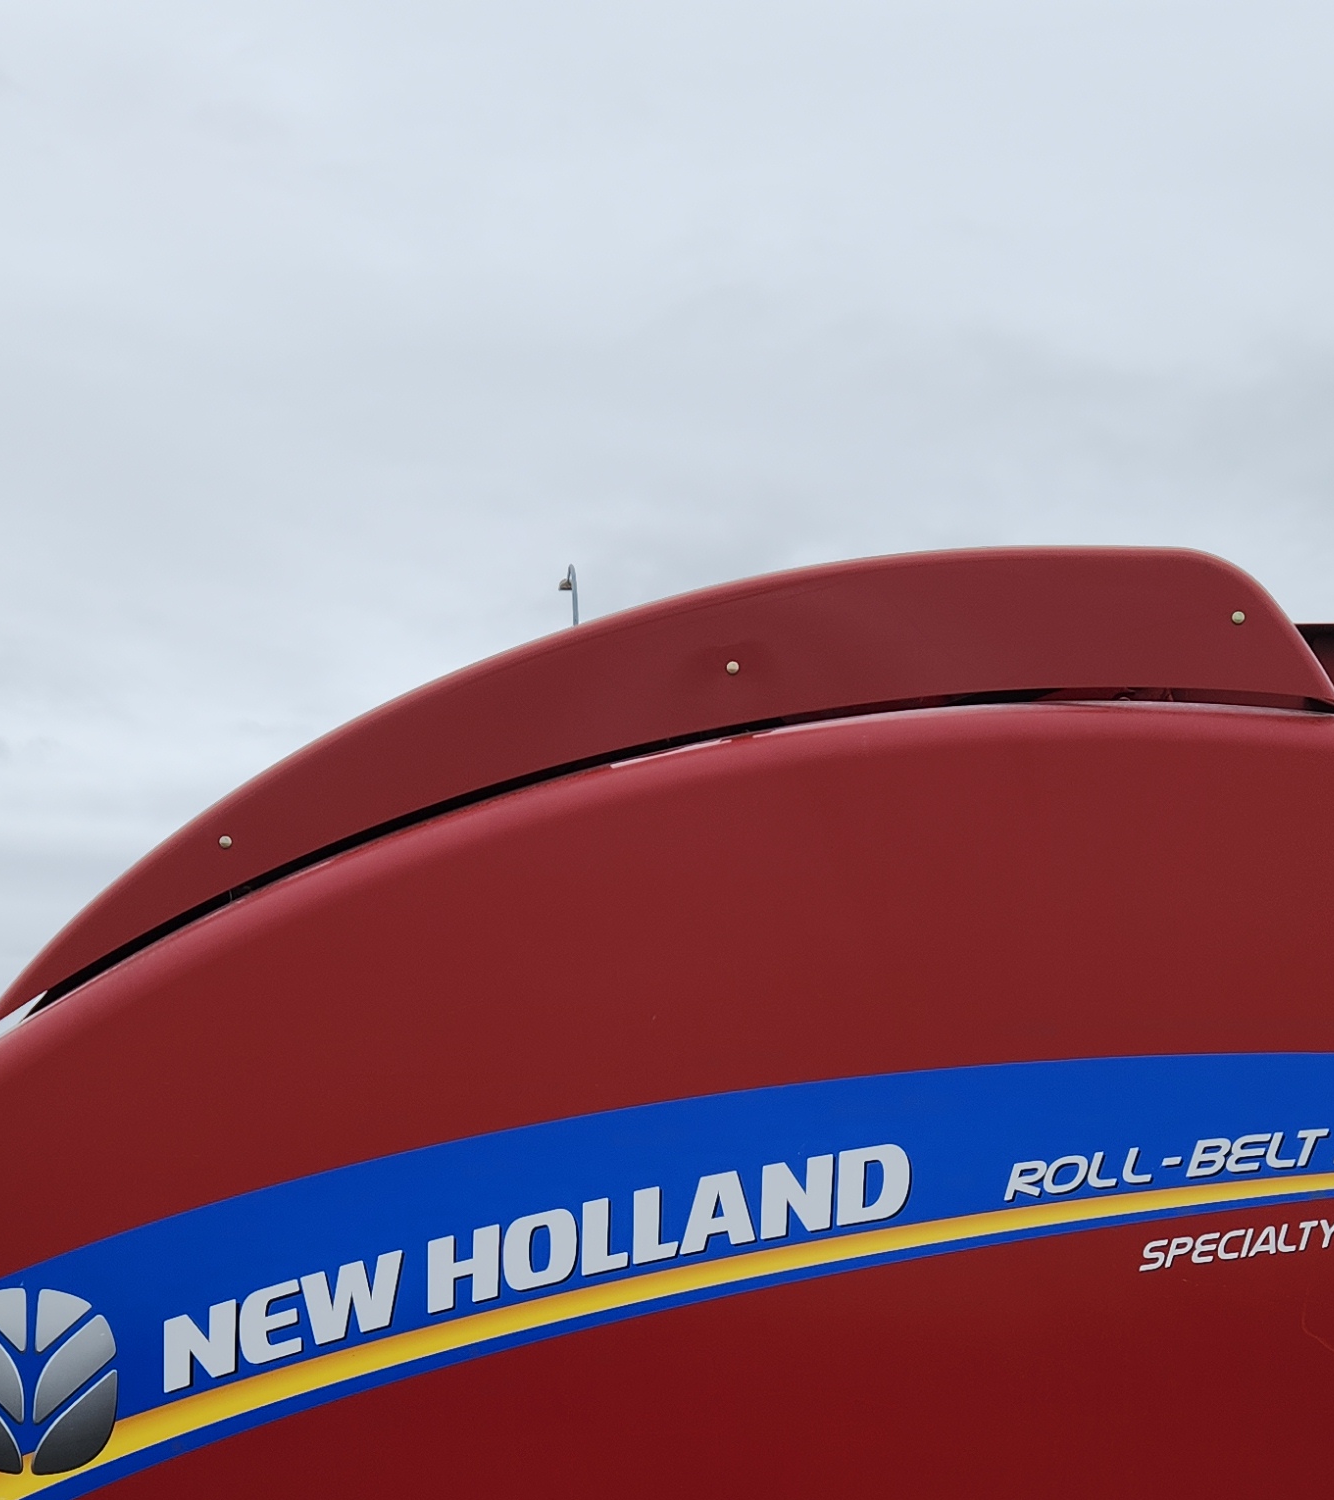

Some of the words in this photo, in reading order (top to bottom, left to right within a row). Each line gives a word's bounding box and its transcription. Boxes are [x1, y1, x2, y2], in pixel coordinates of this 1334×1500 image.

[1003, 1127, 1331, 1202] ROLL-BELT
[162, 1249, 403, 1393] NEW
[425, 1143, 912, 1314] HOLLAND
